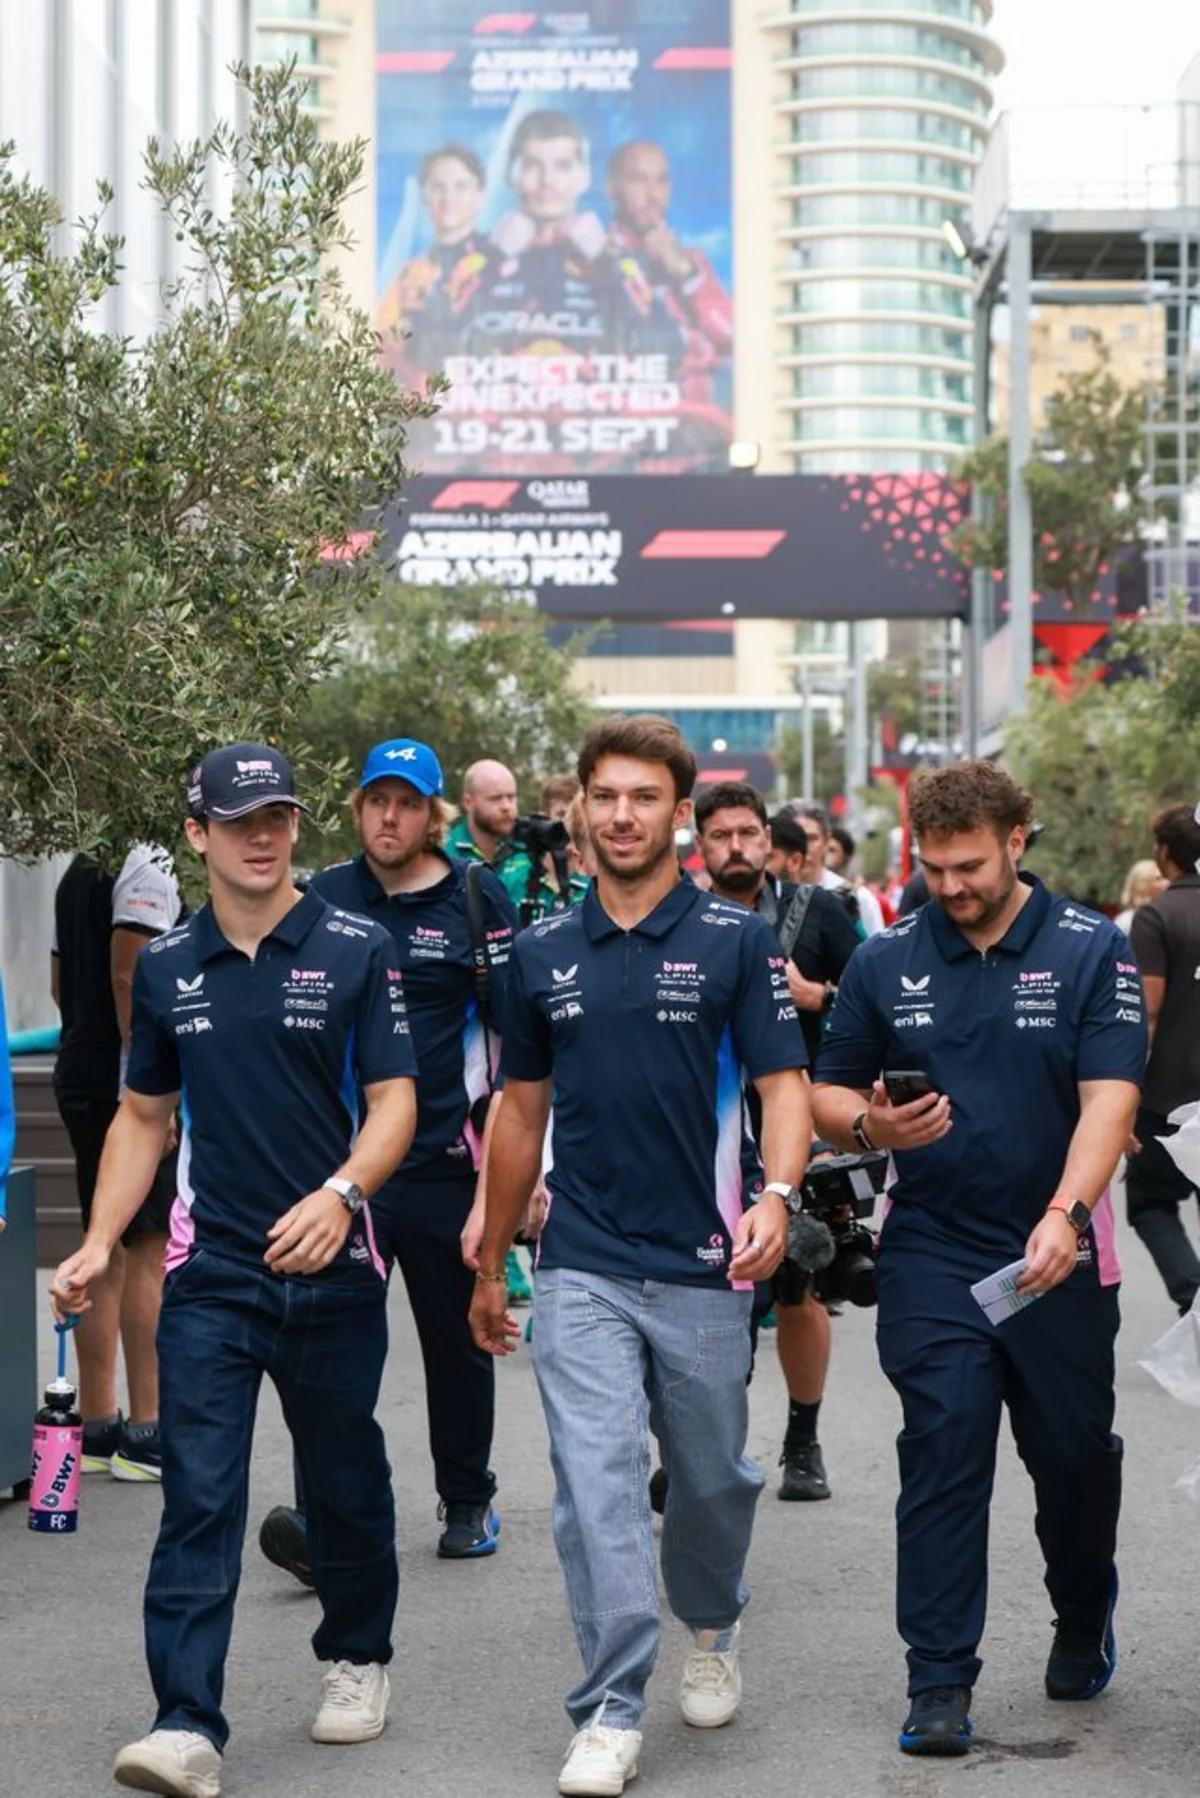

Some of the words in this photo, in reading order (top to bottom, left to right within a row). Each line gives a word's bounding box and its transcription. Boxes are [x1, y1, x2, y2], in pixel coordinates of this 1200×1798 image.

[443, 354, 582, 384] EXPECT
[594, 354, 668, 383] THE
[433, 417, 553, 454] 19-21
[560, 417, 679, 453] SEPT
[400, 557, 530, 587] GRAND
[531, 557, 619, 586] PRIX
[295, 1016, 326, 1031] MSC
[668, 1011, 698, 1023] MSC
[1027, 1017, 1057, 1029] MSC
[51, 1453, 76, 1493] BWT
[50, 1514, 67, 1530] FC
